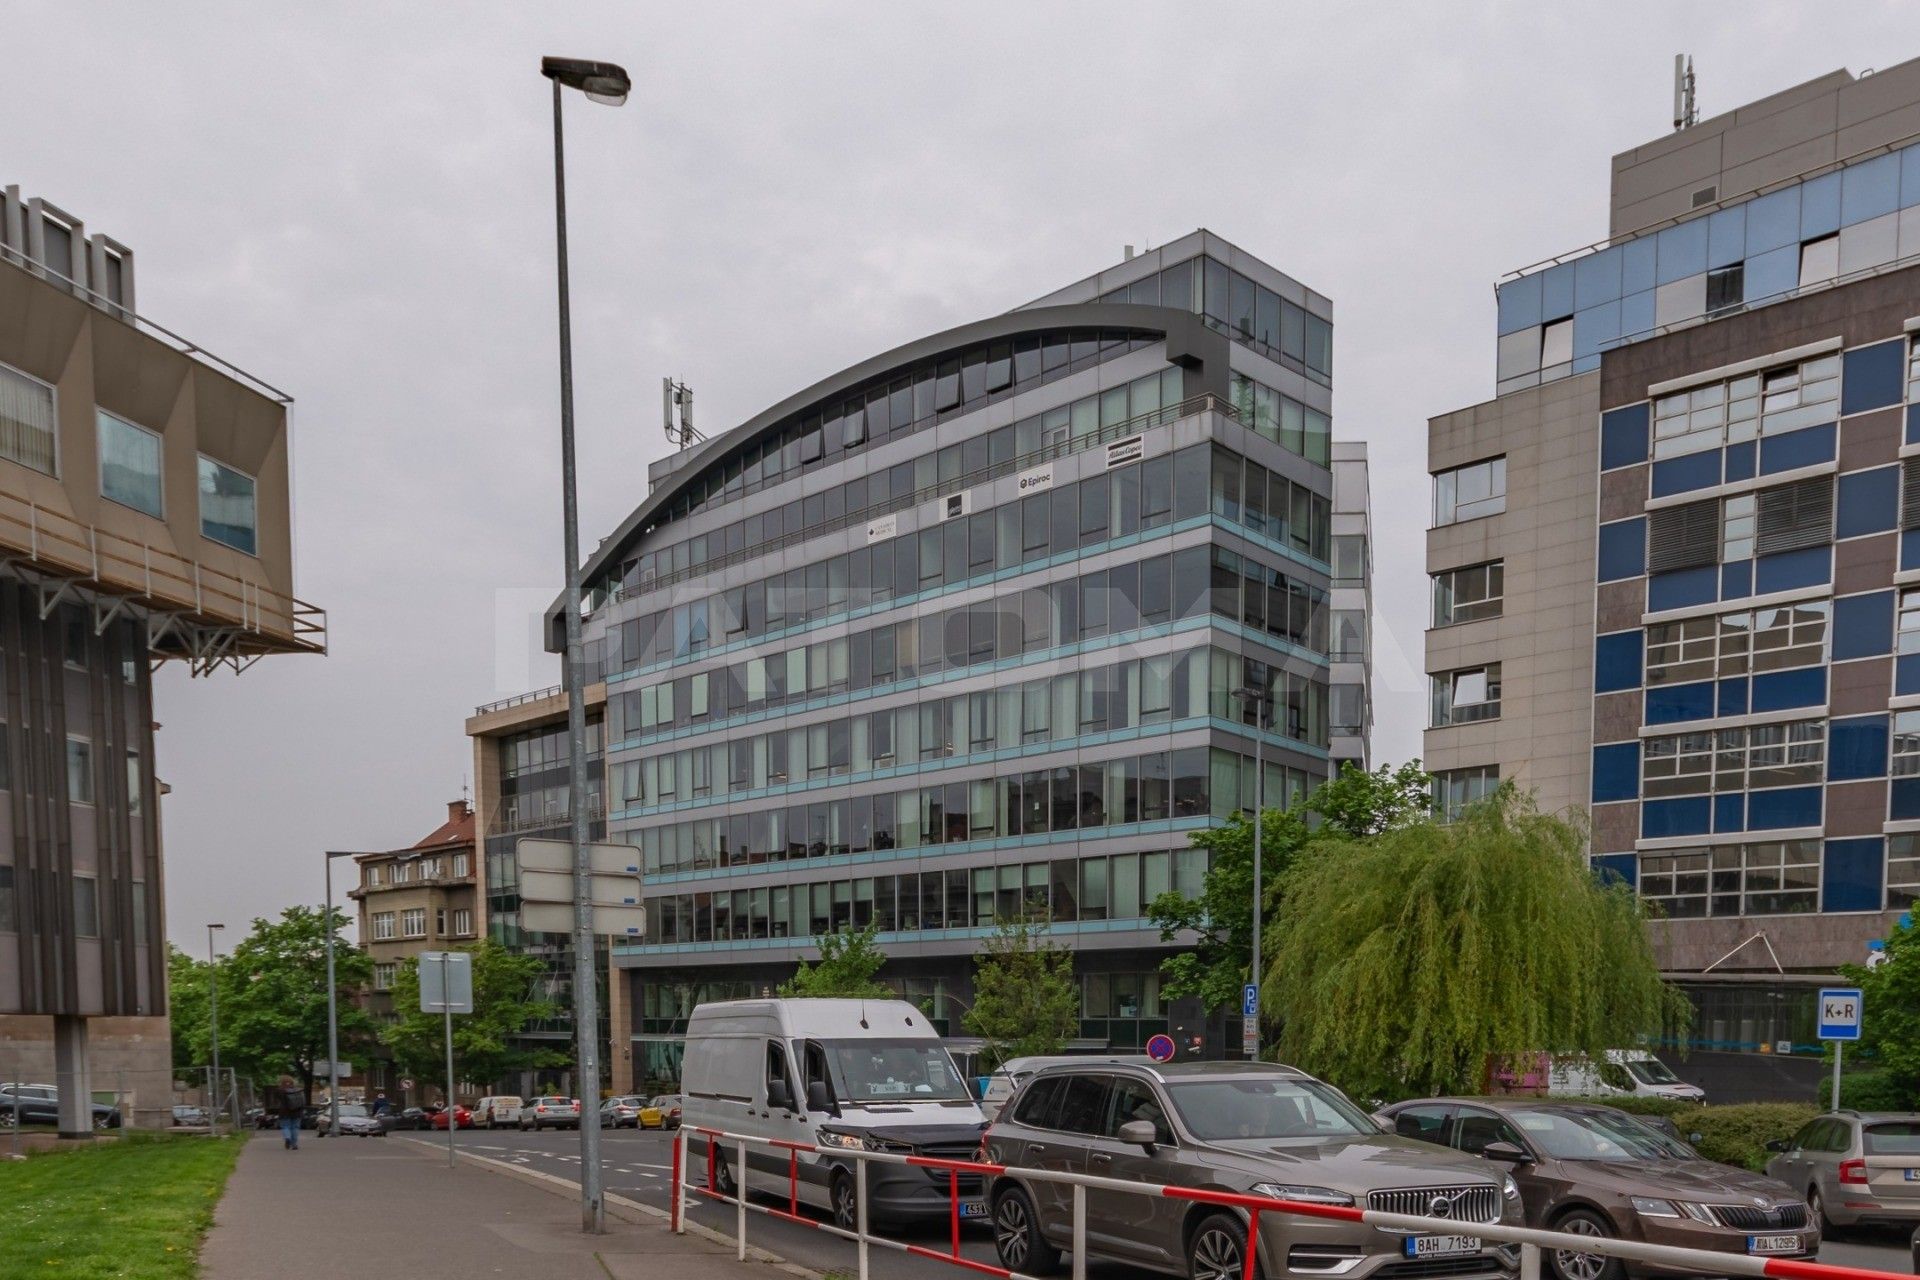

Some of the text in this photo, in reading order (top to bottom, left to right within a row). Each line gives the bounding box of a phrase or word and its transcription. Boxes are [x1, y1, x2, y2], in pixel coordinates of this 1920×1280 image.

[1027, 473, 1051, 487] Epiroc
[1825, 1004, 1853, 1018] K+R
[1418, 1236, 1476, 1252] 8AH 7193
